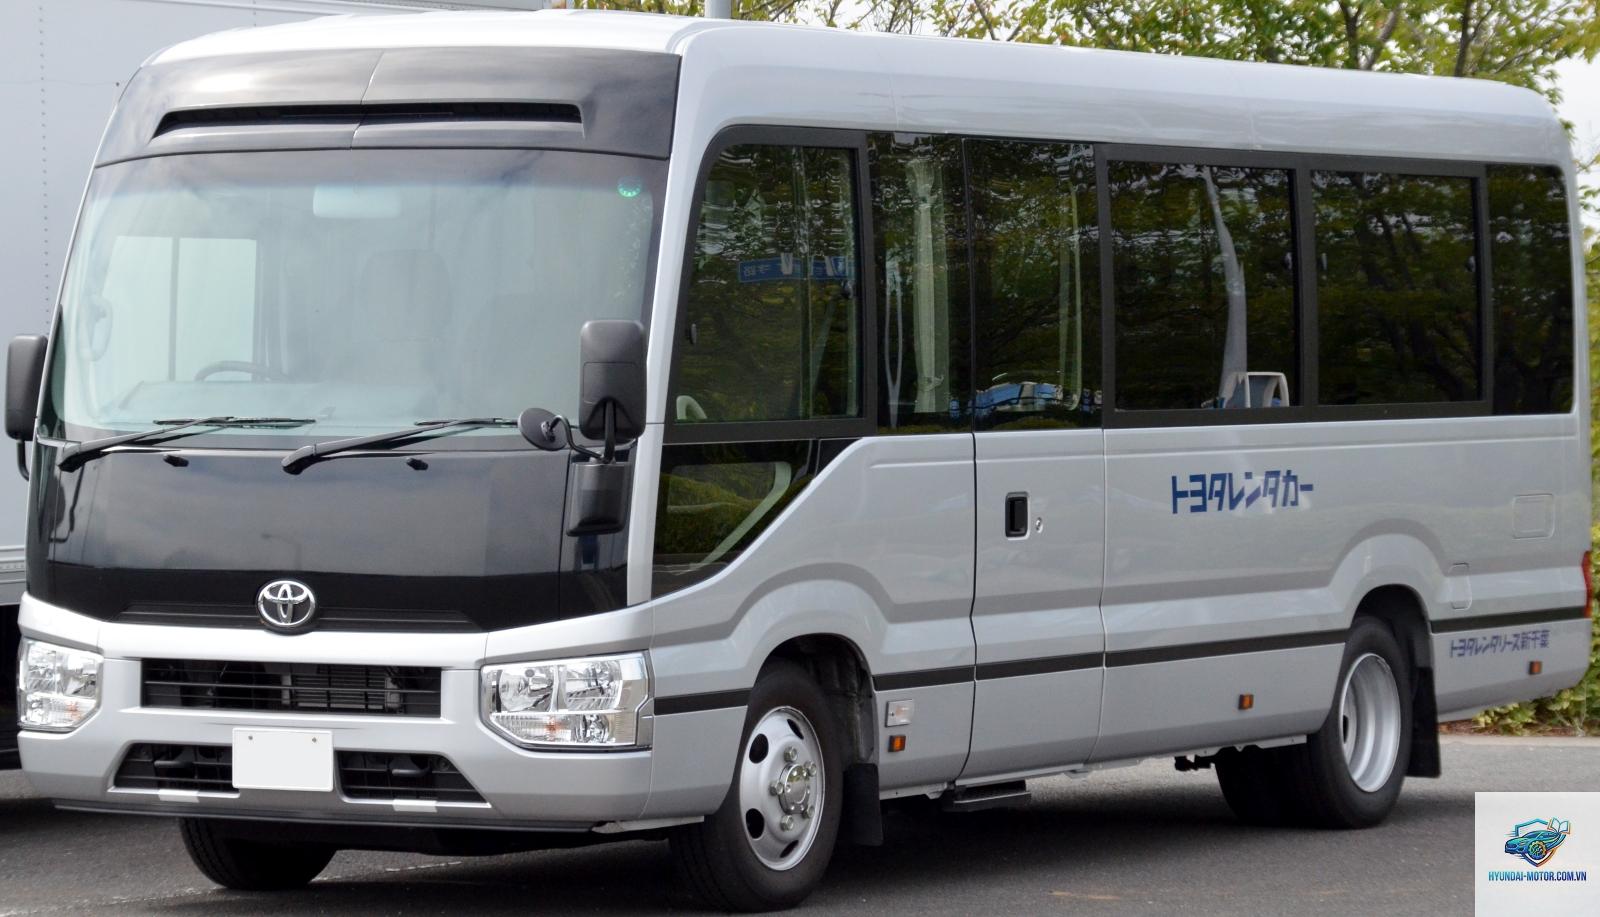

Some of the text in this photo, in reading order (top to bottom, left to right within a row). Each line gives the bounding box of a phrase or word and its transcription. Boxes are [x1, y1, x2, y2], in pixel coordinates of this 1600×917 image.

[1171, 469, 1313, 514] トヨタレンタカー
